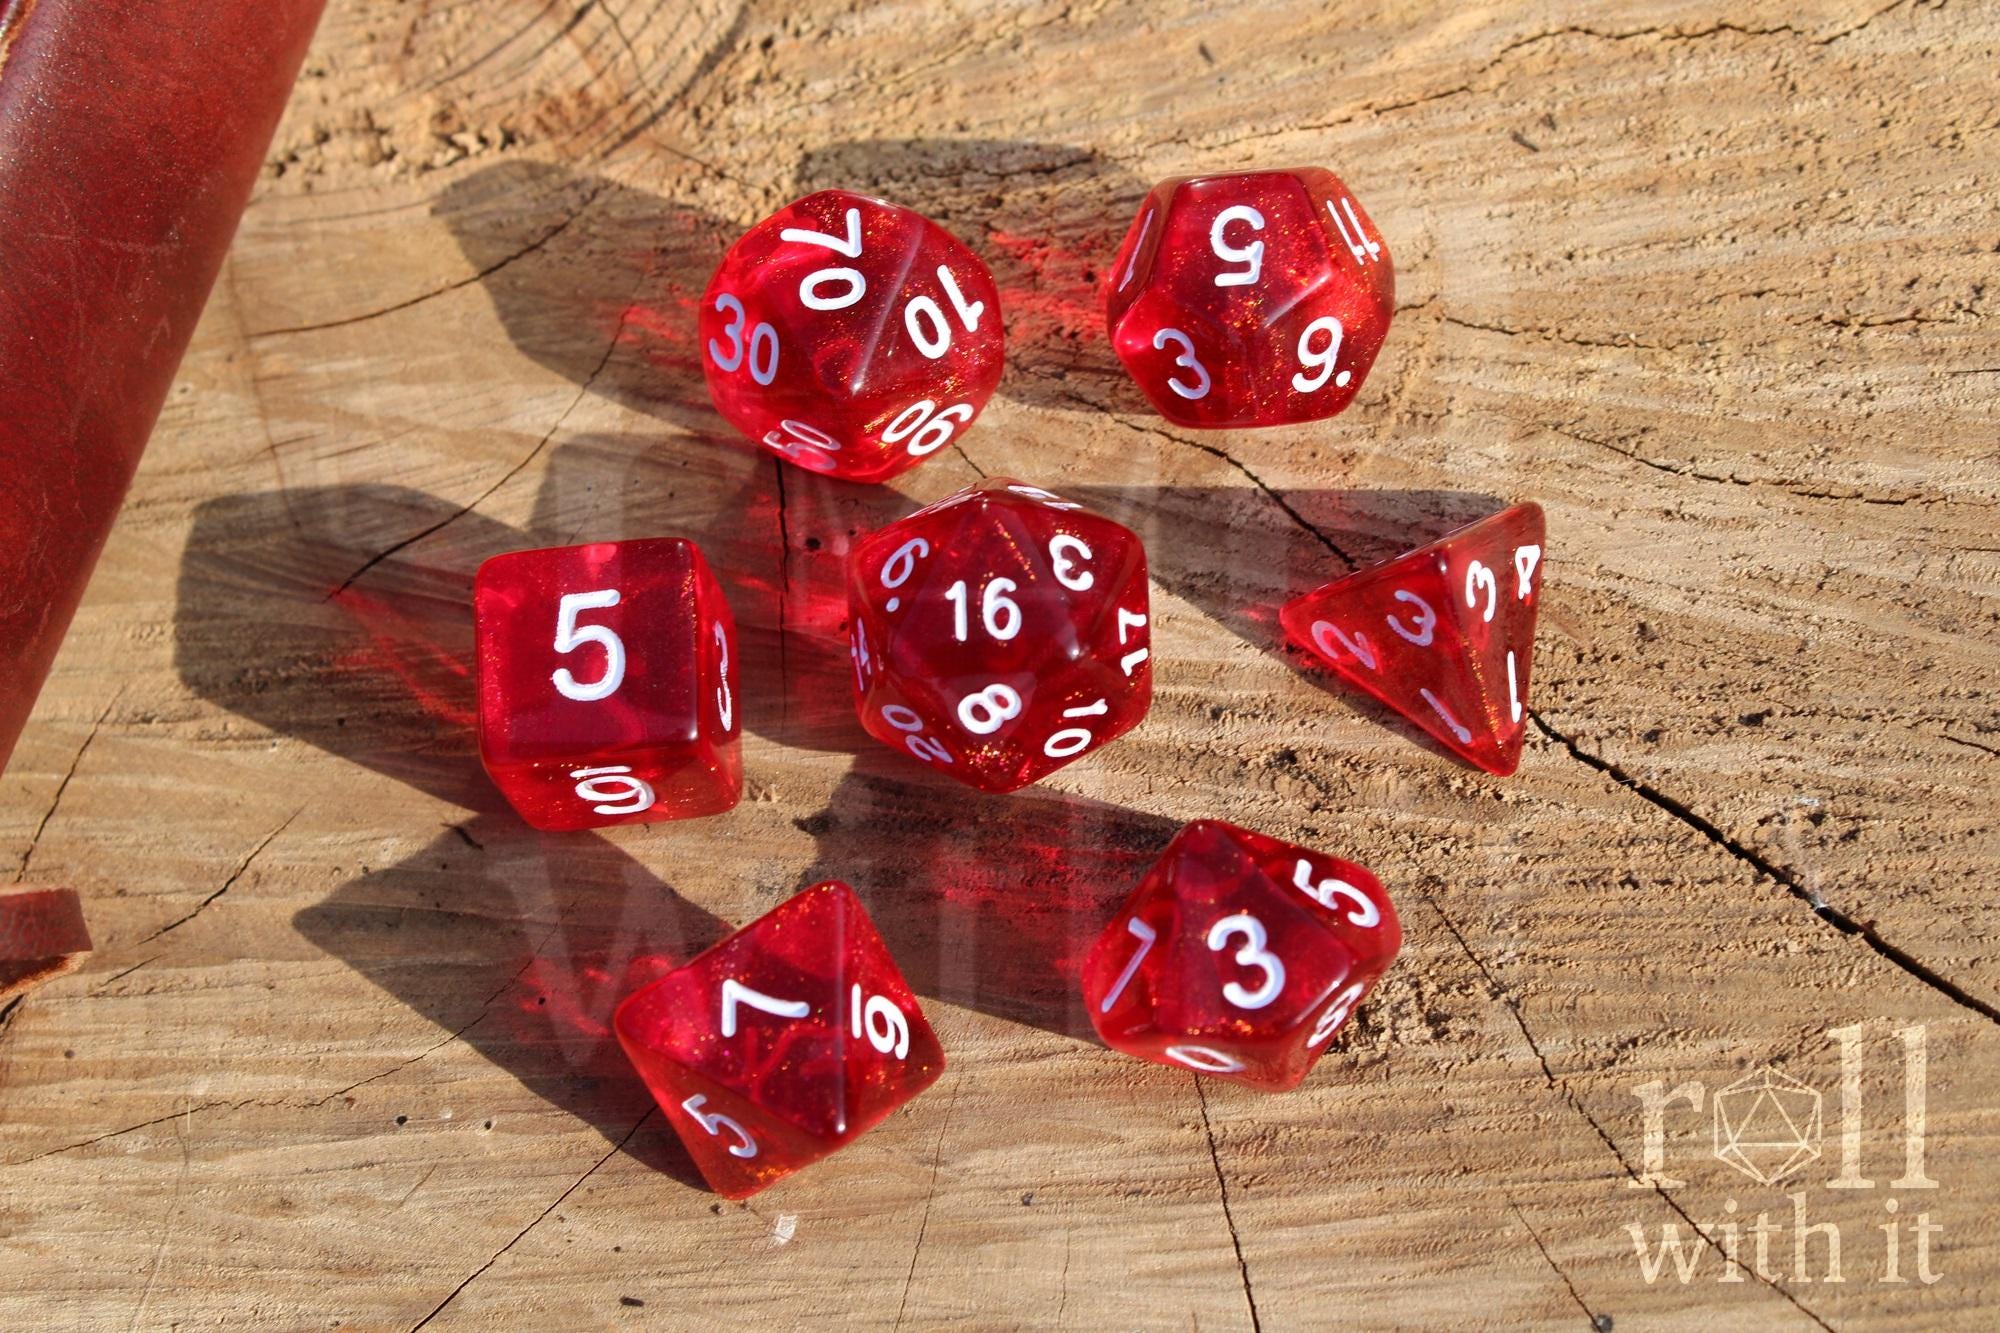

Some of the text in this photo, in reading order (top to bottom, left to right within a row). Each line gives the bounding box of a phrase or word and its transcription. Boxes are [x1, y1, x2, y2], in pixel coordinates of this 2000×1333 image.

[780, 208, 866, 310] 70
[1210, 205, 1265, 287] 5
[1326, 197, 1381, 266] 11
[709, 293, 780, 386] 30
[904, 264, 984, 359] 10
[1153, 328, 1211, 400] 3
[881, 400, 974, 456] 90
[1049, 534, 1094, 591] 3
[1466, 560, 1497, 622] 3
[944, 577, 1022, 642] 16
[1118, 607, 1149, 677] 17
[1387, 590, 1437, 647] 3
[552, 588, 627, 702] 5
[1311, 620, 1376, 670] 2
[957, 683, 1022, 734] 8
[1420, 688, 1472, 744] 1
[1507, 650, 1522, 724] 1
[881, 704, 953, 763] 20
[1044, 698, 1108, 758] 10
[1293, 858, 1381, 928] 5
[1101, 916, 1157, 1014] 7
[1207, 914, 1286, 1010] 3
[721, 978, 810, 1038] 7
[1165, 1046, 1246, 1073] 0
[681, 1093, 758, 1159] 5
